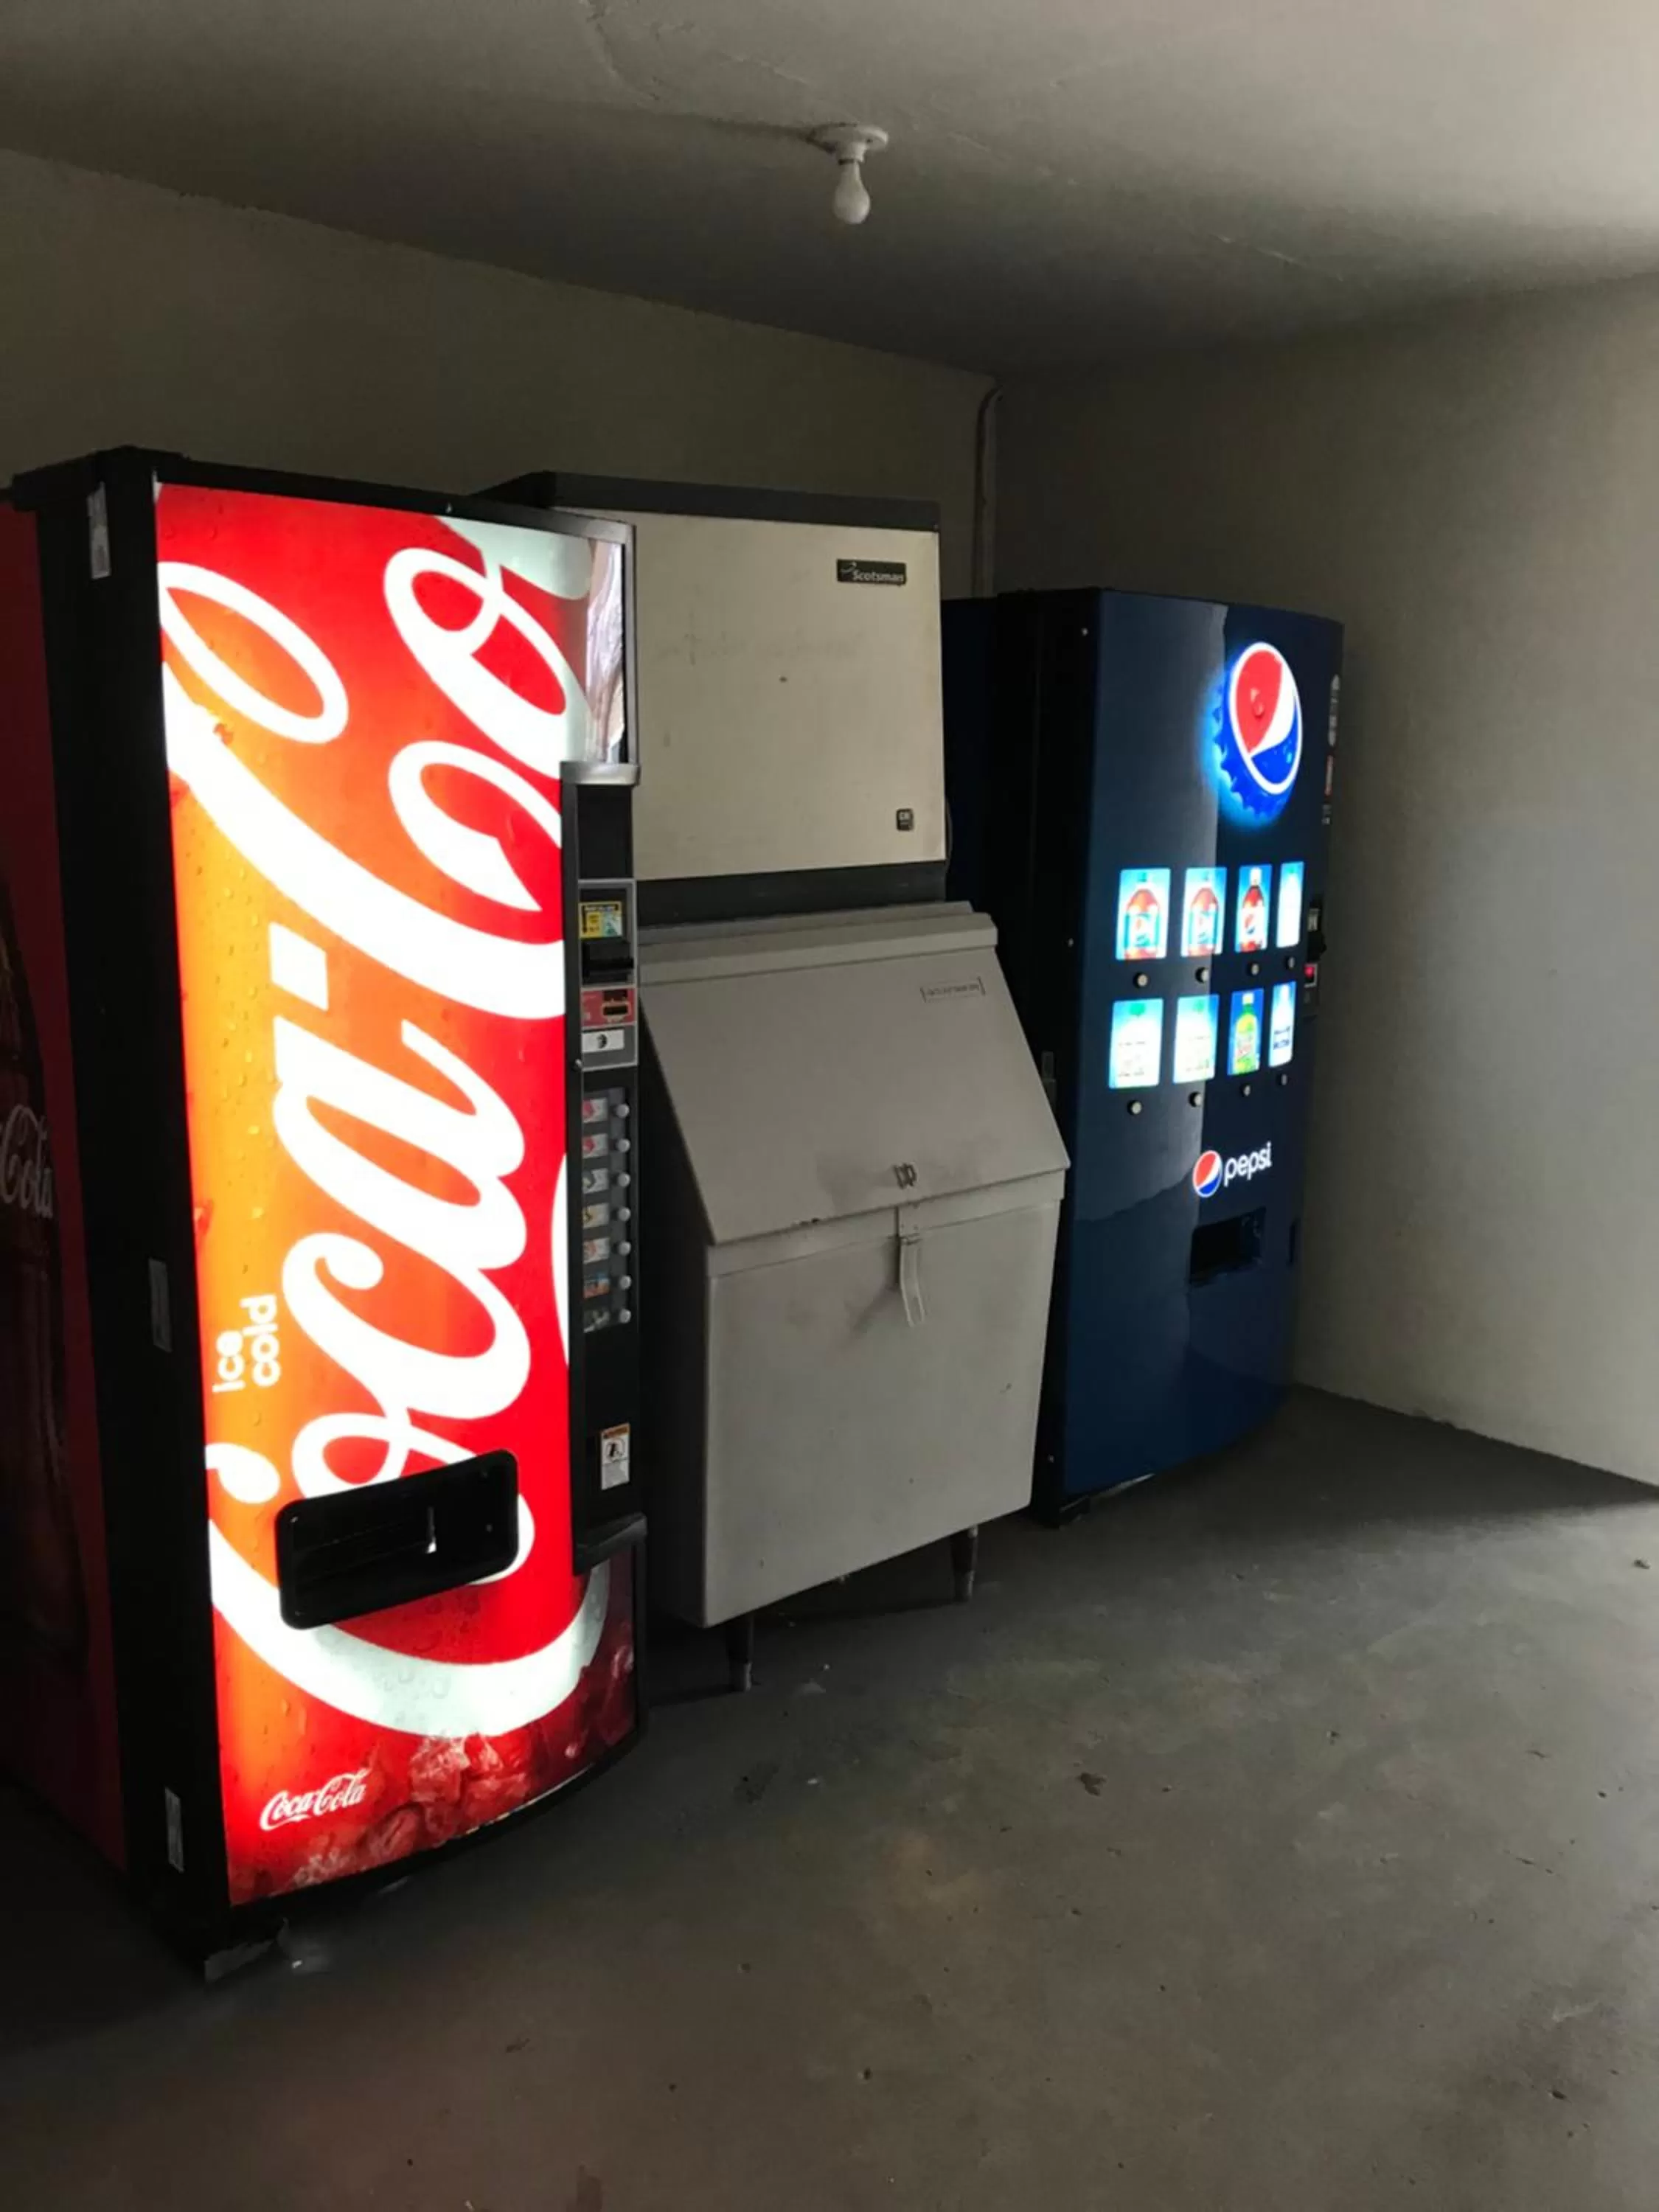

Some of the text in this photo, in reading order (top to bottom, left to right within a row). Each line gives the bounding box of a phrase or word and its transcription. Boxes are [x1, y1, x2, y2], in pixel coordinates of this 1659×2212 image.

[1223, 1141, 1273, 1187] pepsi
[239, 1292, 282, 1388] cold
[259, 1767, 371, 1832] Coca-Cola
